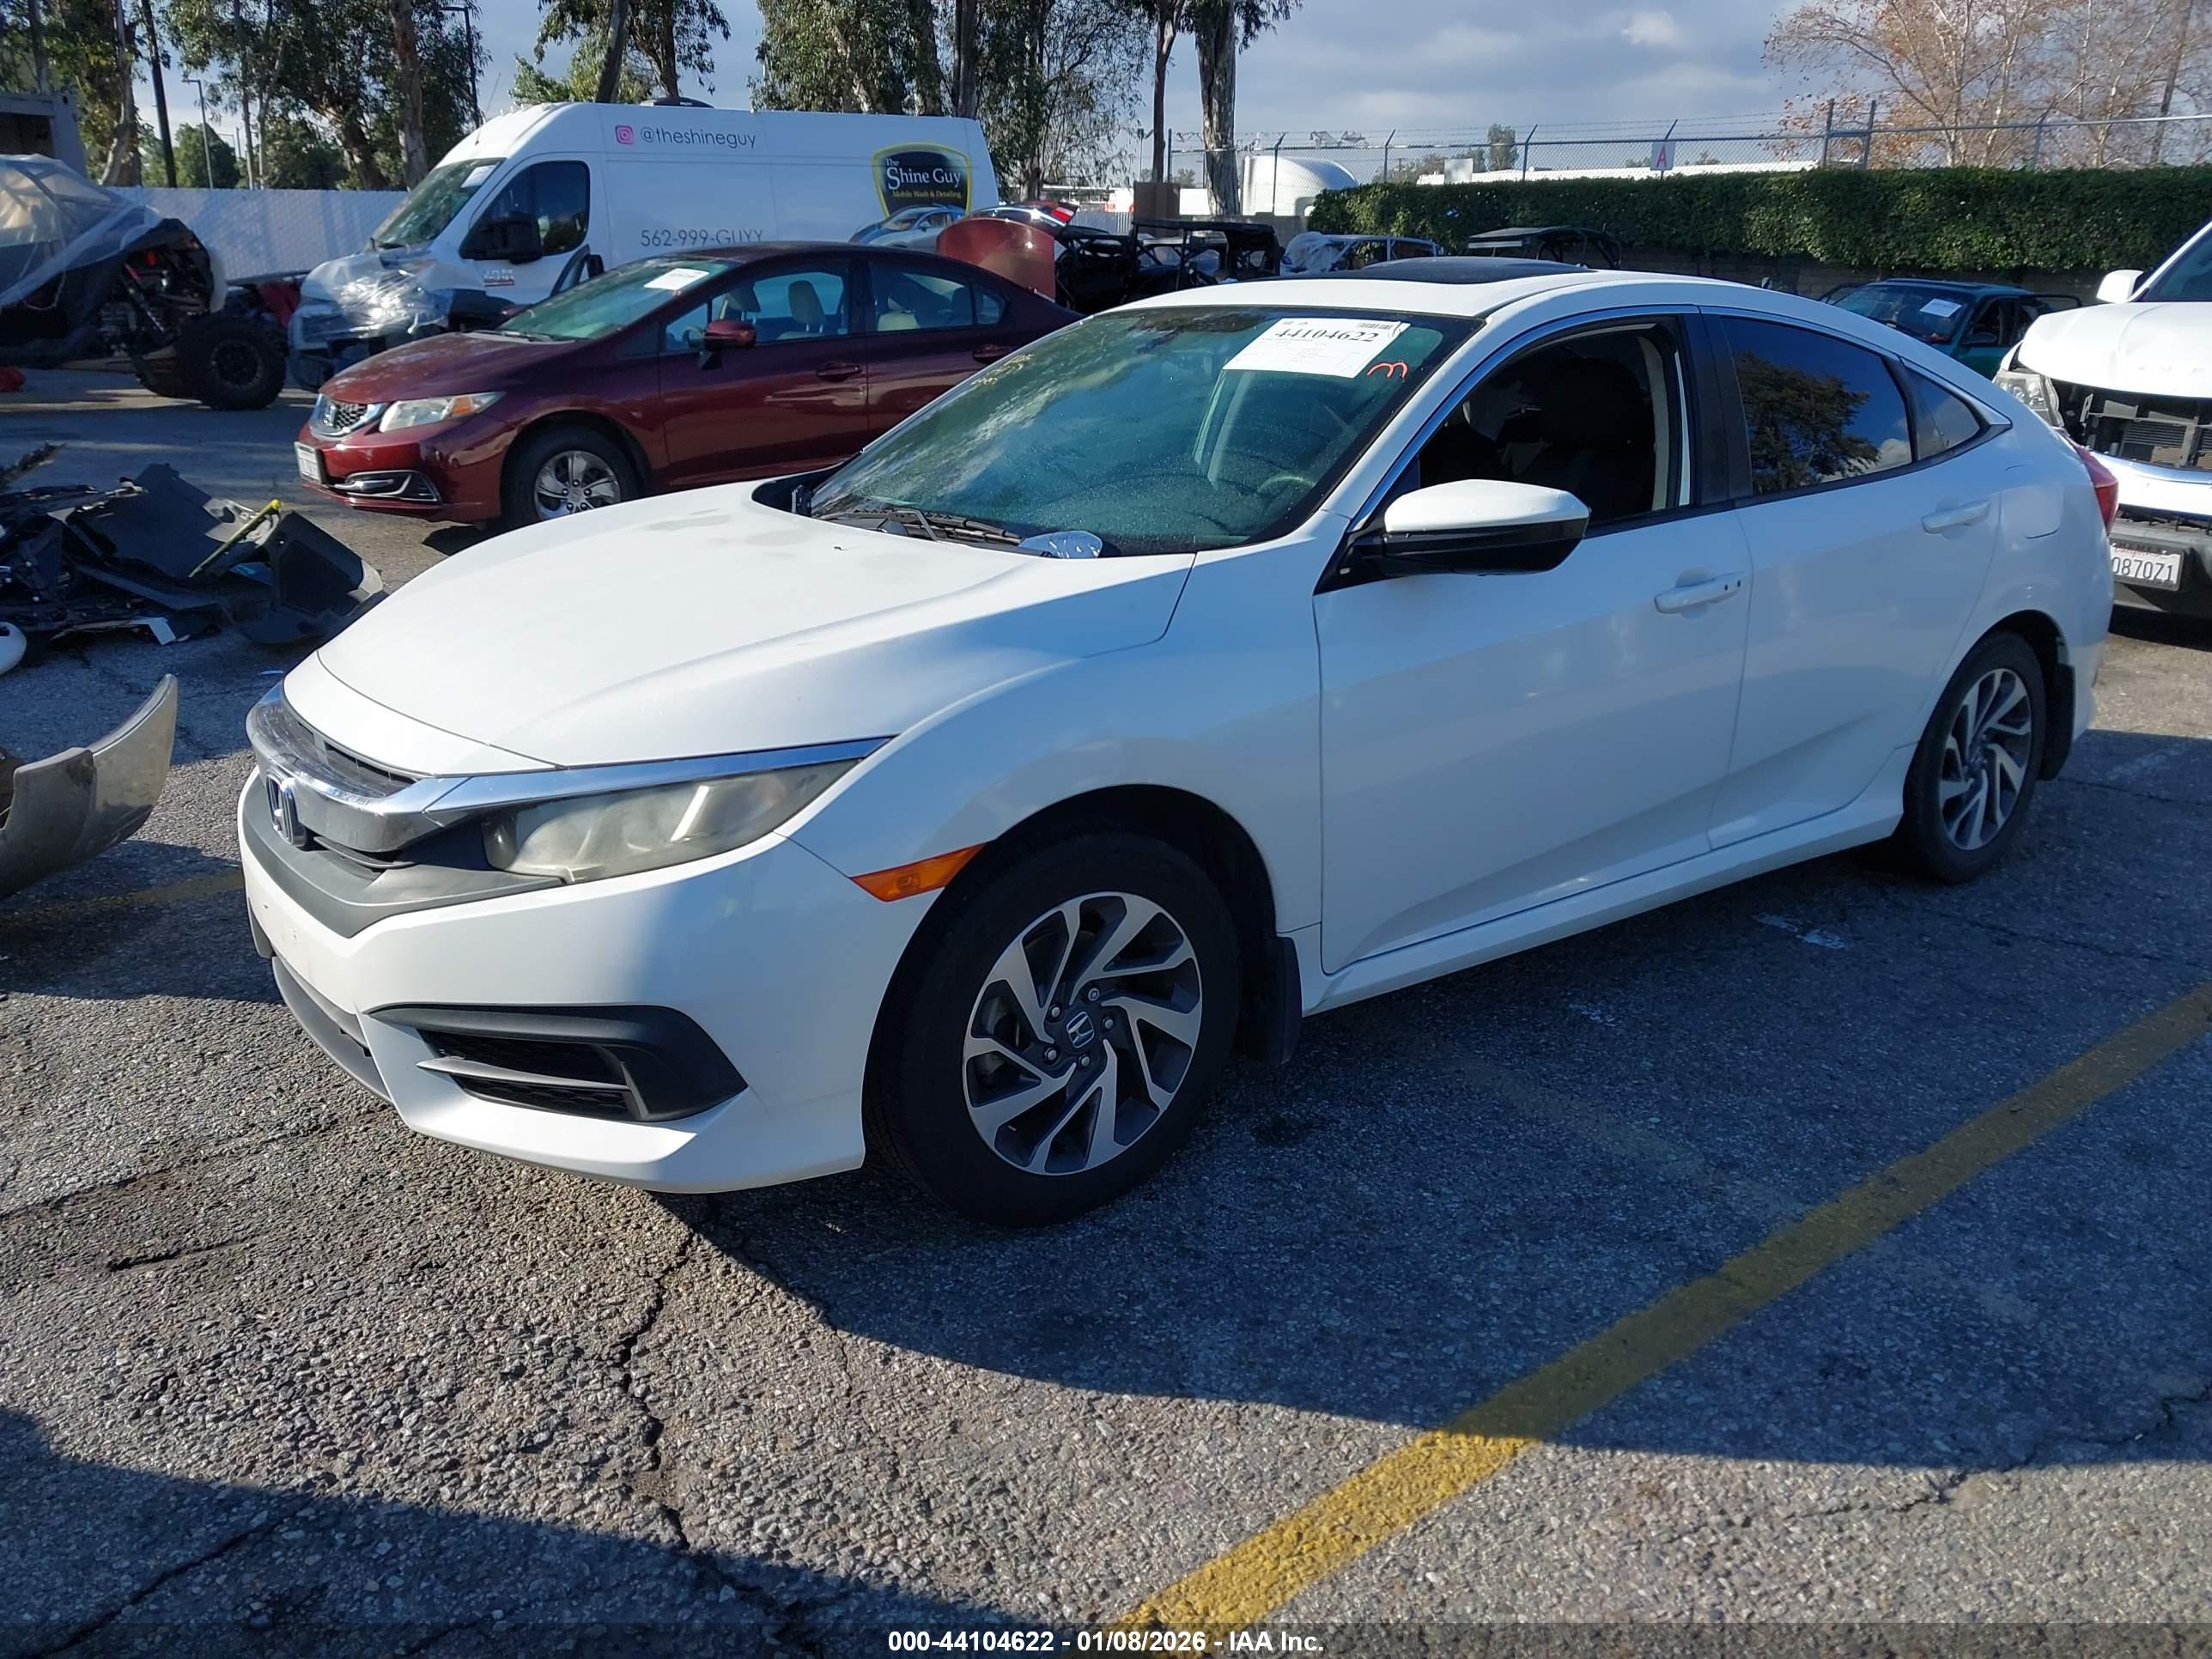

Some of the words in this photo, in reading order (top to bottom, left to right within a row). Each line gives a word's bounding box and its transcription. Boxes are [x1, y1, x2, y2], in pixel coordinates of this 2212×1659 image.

[641, 127, 756, 149] @theshineguy
[886, 158, 900, 167] The
[1656, 143, 1668, 167] A
[886, 167, 930, 189] Shine
[933, 167, 961, 188] Guy
[641, 229, 763, 246] 562-999-GUYY
[1274, 328, 1379, 343] 44104622
